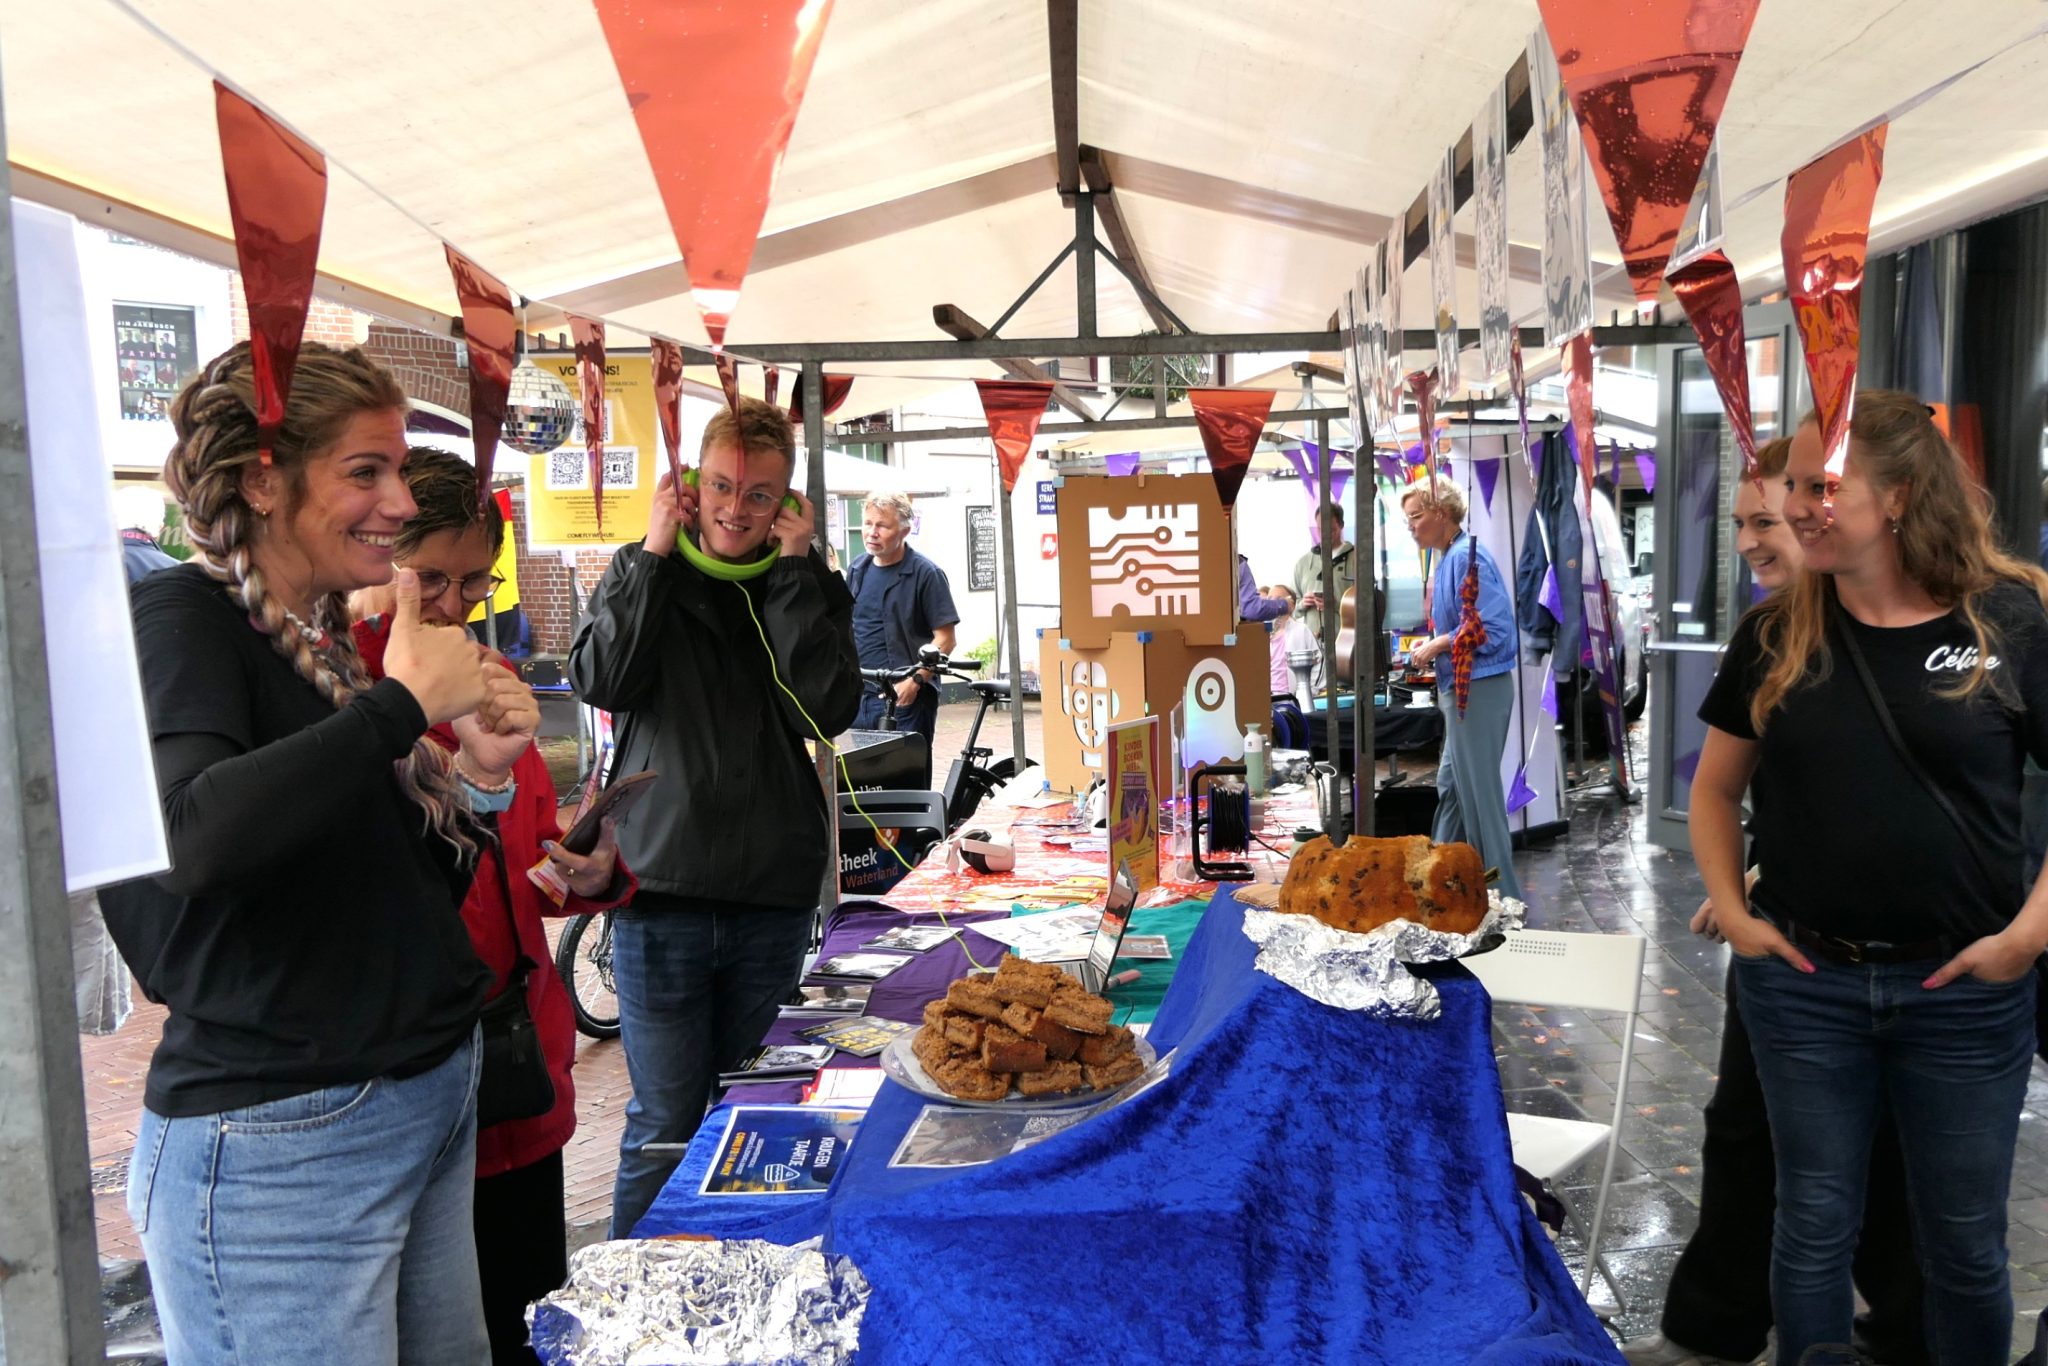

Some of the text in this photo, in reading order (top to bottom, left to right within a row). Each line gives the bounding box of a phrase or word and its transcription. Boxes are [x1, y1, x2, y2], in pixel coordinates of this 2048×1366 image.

[119, 350, 176, 359] FATHER
[122, 381, 179, 391] MOTHER
[845, 862, 899, 889] Waterland
